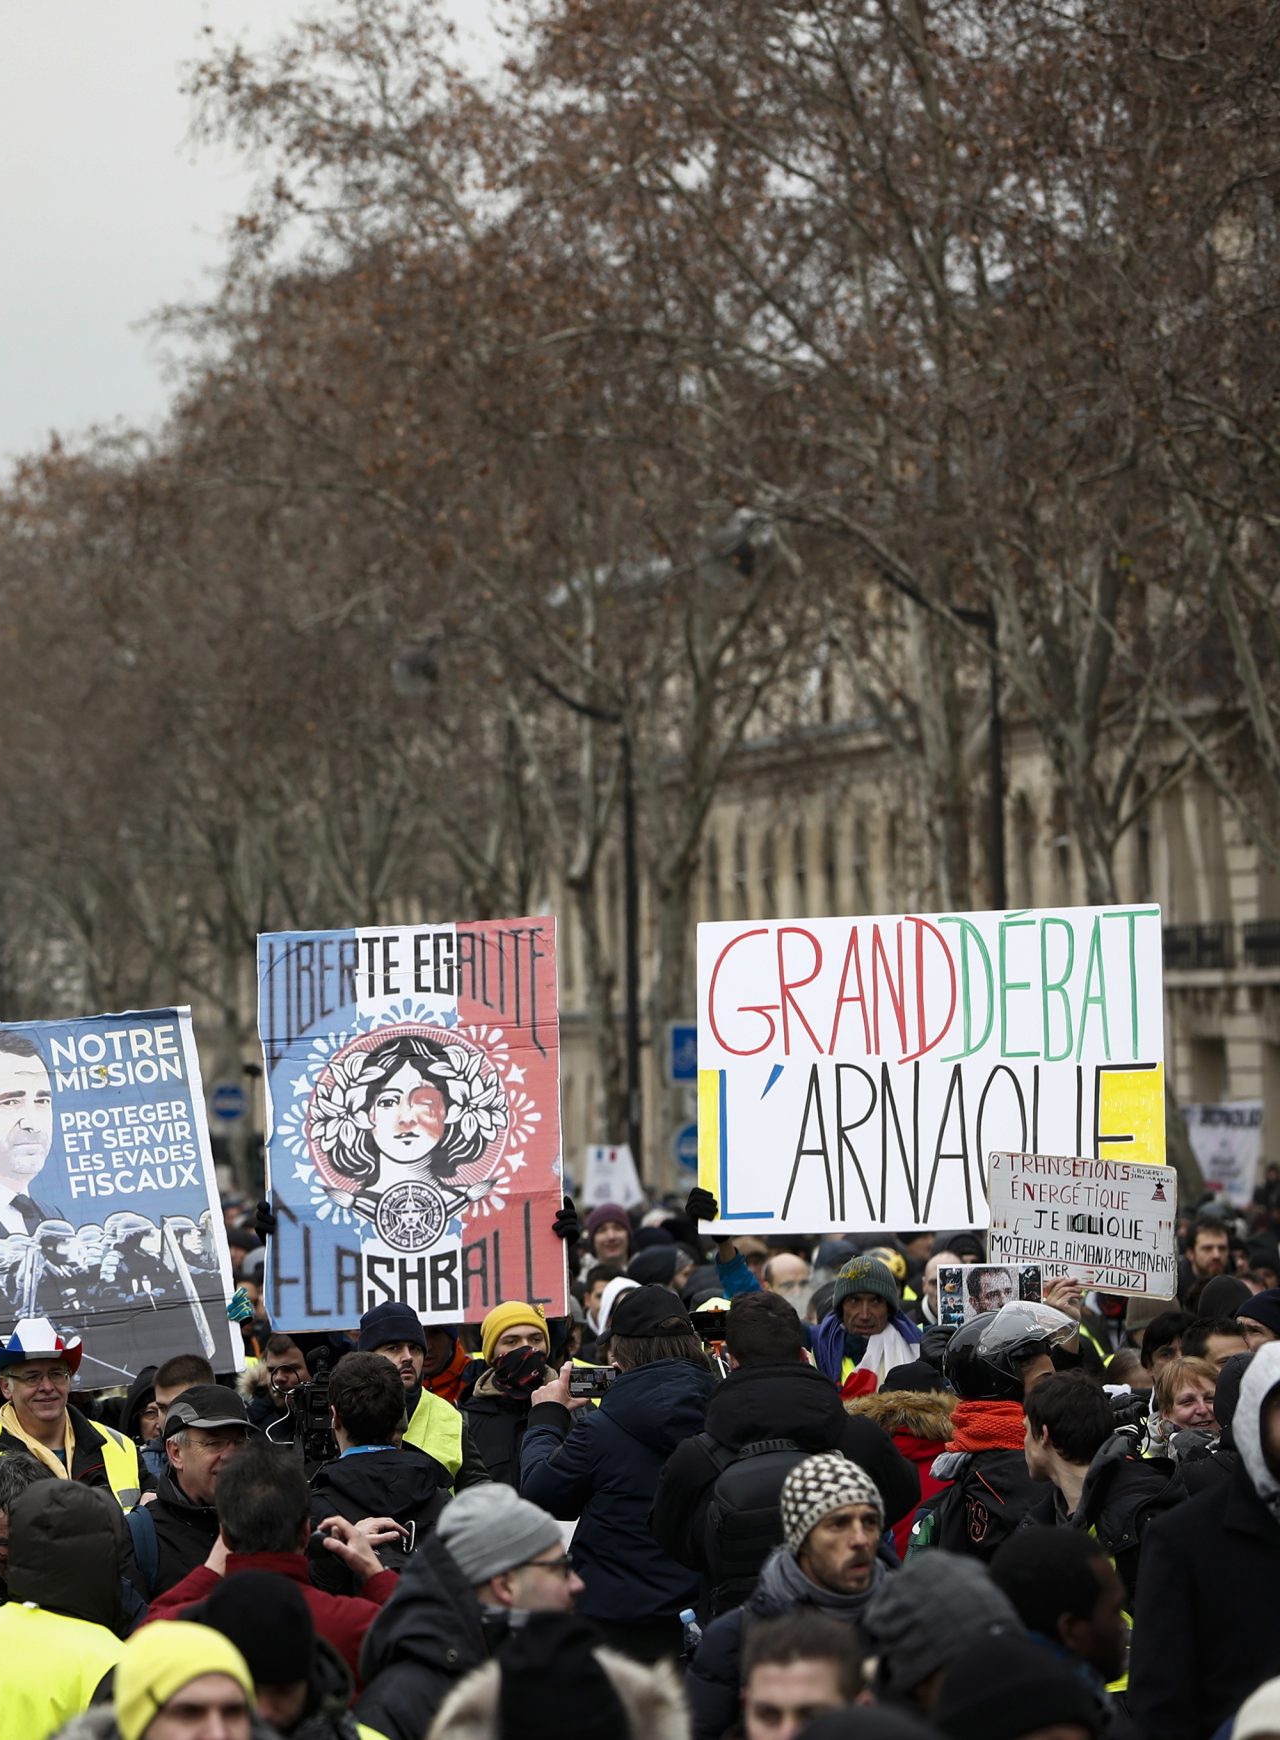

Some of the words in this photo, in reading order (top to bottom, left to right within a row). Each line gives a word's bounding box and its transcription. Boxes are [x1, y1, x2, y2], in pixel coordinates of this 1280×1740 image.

[267, 935, 400, 1071] LIBERTE
[413, 928, 548, 1058] EGALITE
[708, 916, 957, 1065] GRAND
[938, 909, 1160, 1063] DÉBAT
[49, 1025, 178, 1066] NOTRE
[54, 1055, 183, 1092] MISSION
[60, 1100, 188, 1132] PROTEGER
[63, 1131, 94, 1153] ET
[102, 1121, 193, 1149] SERVIR
[66, 1153, 106, 1173] LES
[111, 1143, 197, 1169] EVADES
[992, 1154, 1001, 1169] 2
[69, 1162, 200, 1199] FISCAUX
[1034, 1210, 1060, 1232] JE
[271, 1188, 553, 1318] FLASHBALL
